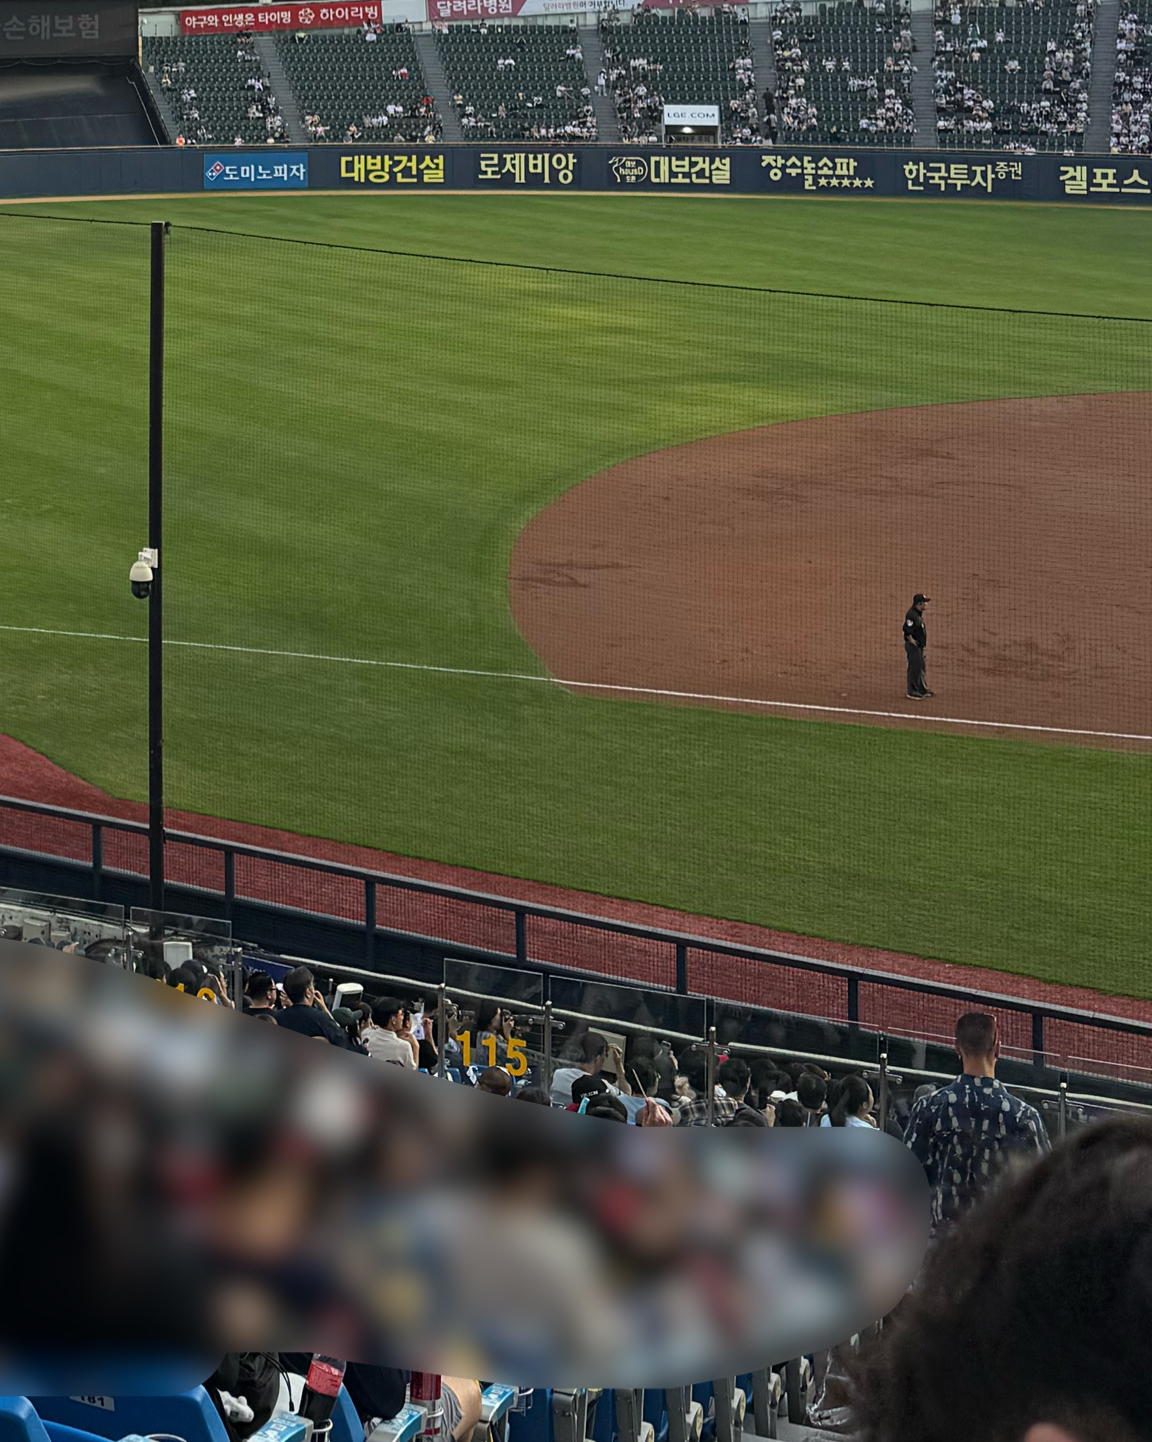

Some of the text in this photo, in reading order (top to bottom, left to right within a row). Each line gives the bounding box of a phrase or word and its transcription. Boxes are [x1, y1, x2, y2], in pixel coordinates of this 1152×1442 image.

[185, 5, 378, 29] 야구와 인생은 타이밍 하이리빙
[223, 163, 306, 182] 도미노피자
[340, 155, 445, 184] 대방건설
[478, 152, 576, 185] 로제비앙
[650, 156, 731, 184] 대보건설
[1059, 166, 1151, 195] 겔포스
[456, 1030, 528, 1077] 115
